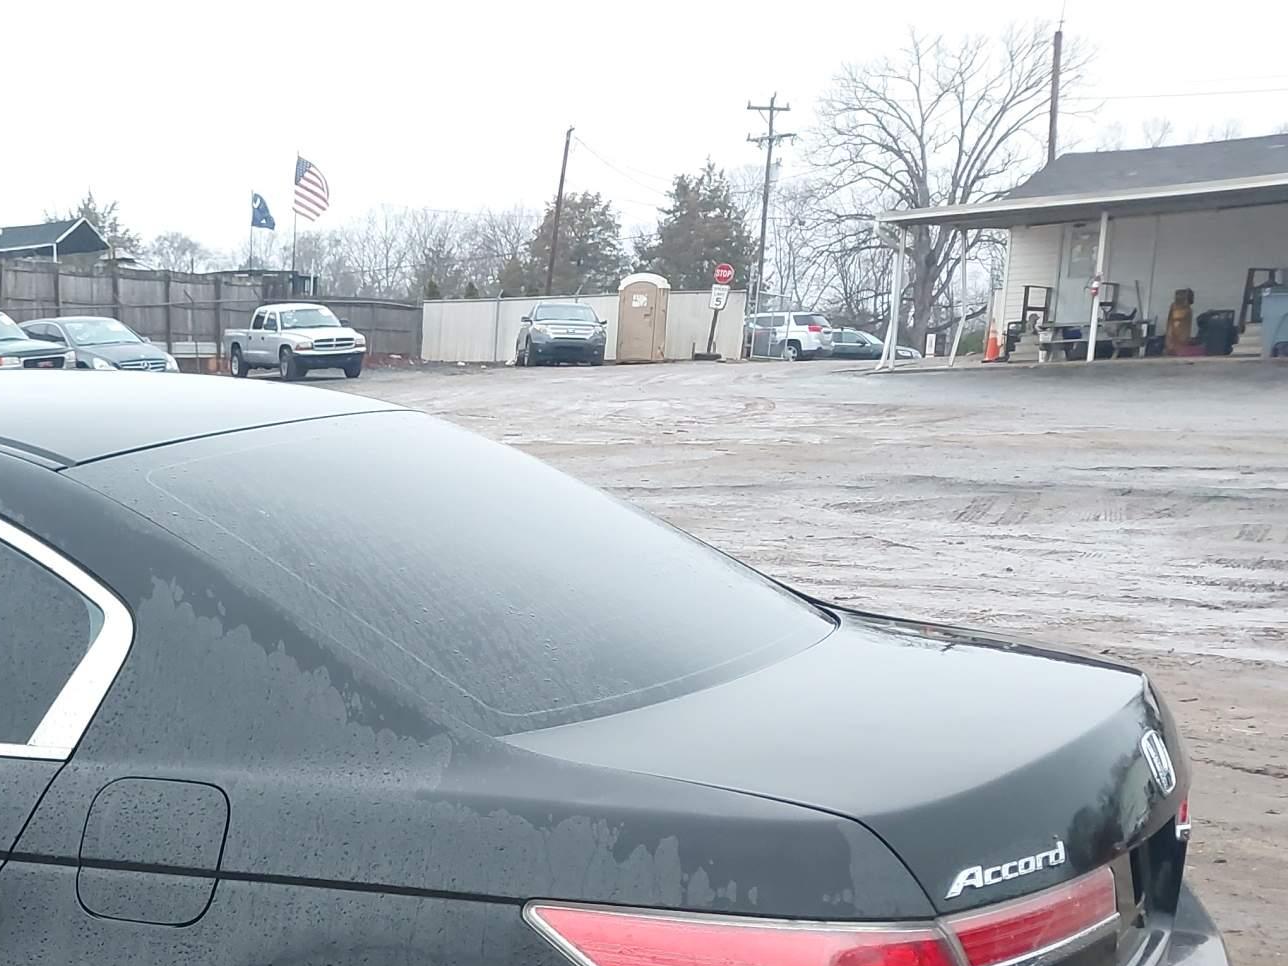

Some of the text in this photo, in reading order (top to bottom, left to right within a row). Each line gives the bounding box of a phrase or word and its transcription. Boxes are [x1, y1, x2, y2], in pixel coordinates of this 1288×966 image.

[716, 269, 732, 278] STOP
[715, 297, 722, 306] 5
[944, 840, 1066, 900] Accord
